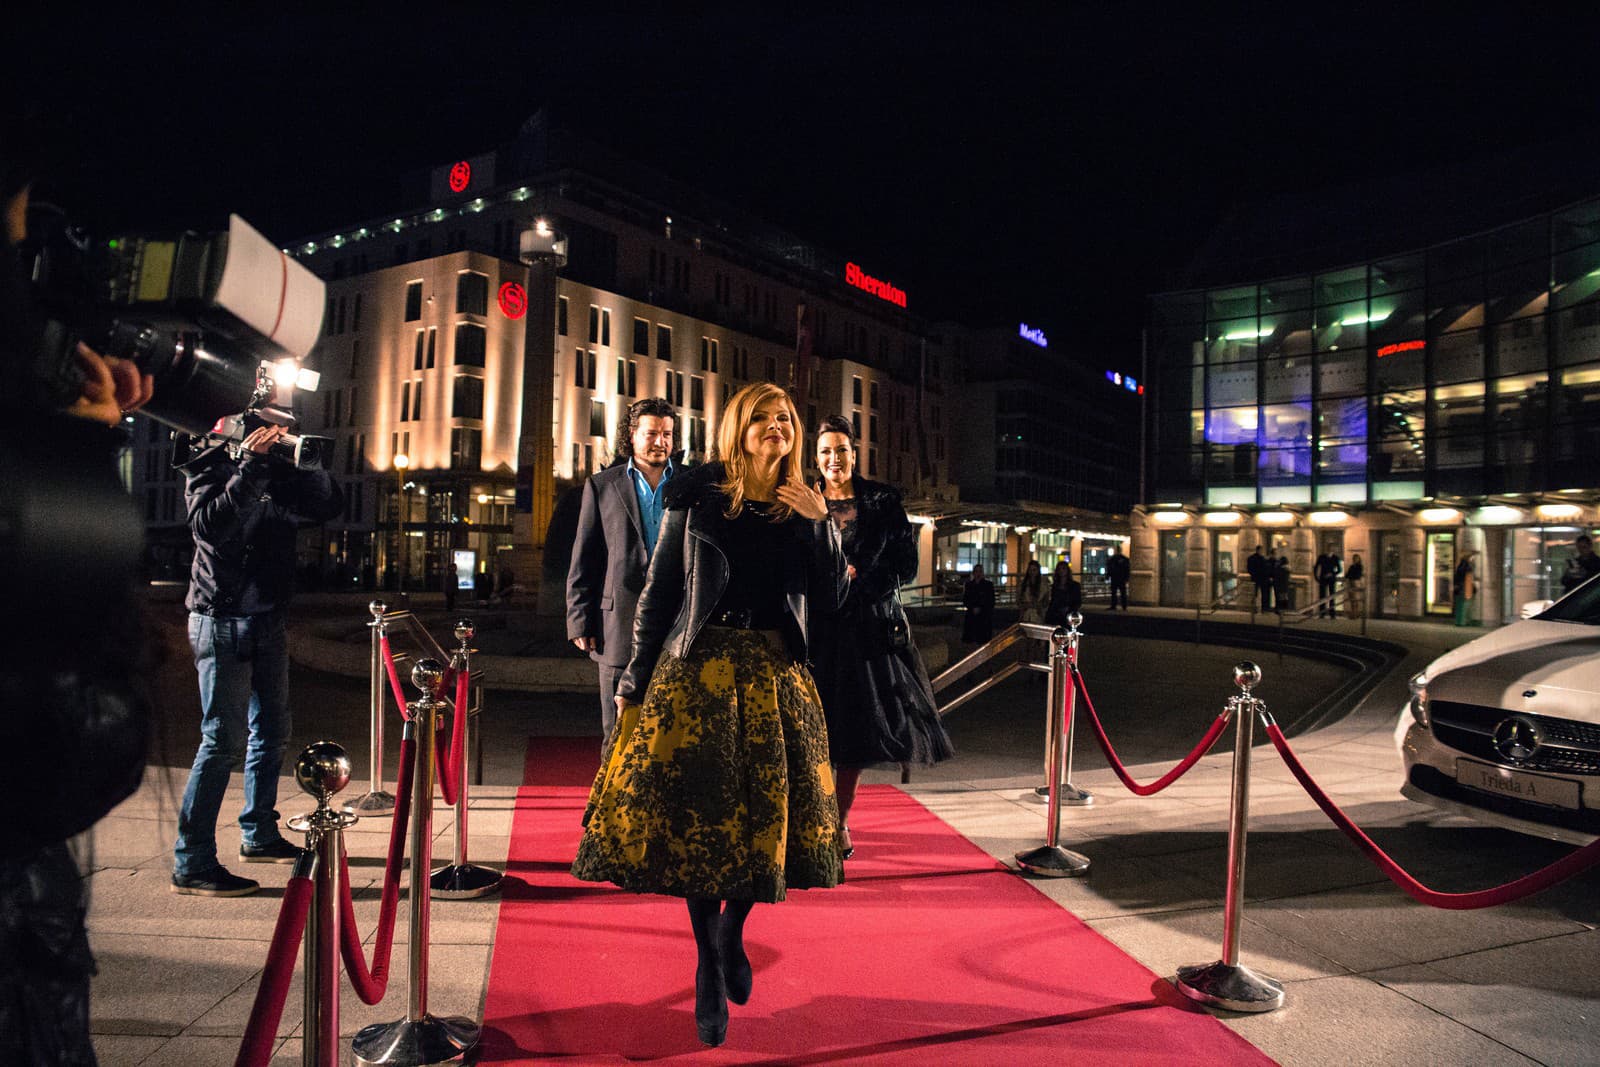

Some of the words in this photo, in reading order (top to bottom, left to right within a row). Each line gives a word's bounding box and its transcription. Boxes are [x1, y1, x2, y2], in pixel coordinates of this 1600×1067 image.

[846, 262, 906, 308] Sheraton
[1480, 770, 1521, 793] Trieda
[1526, 781, 1537, 796] A
